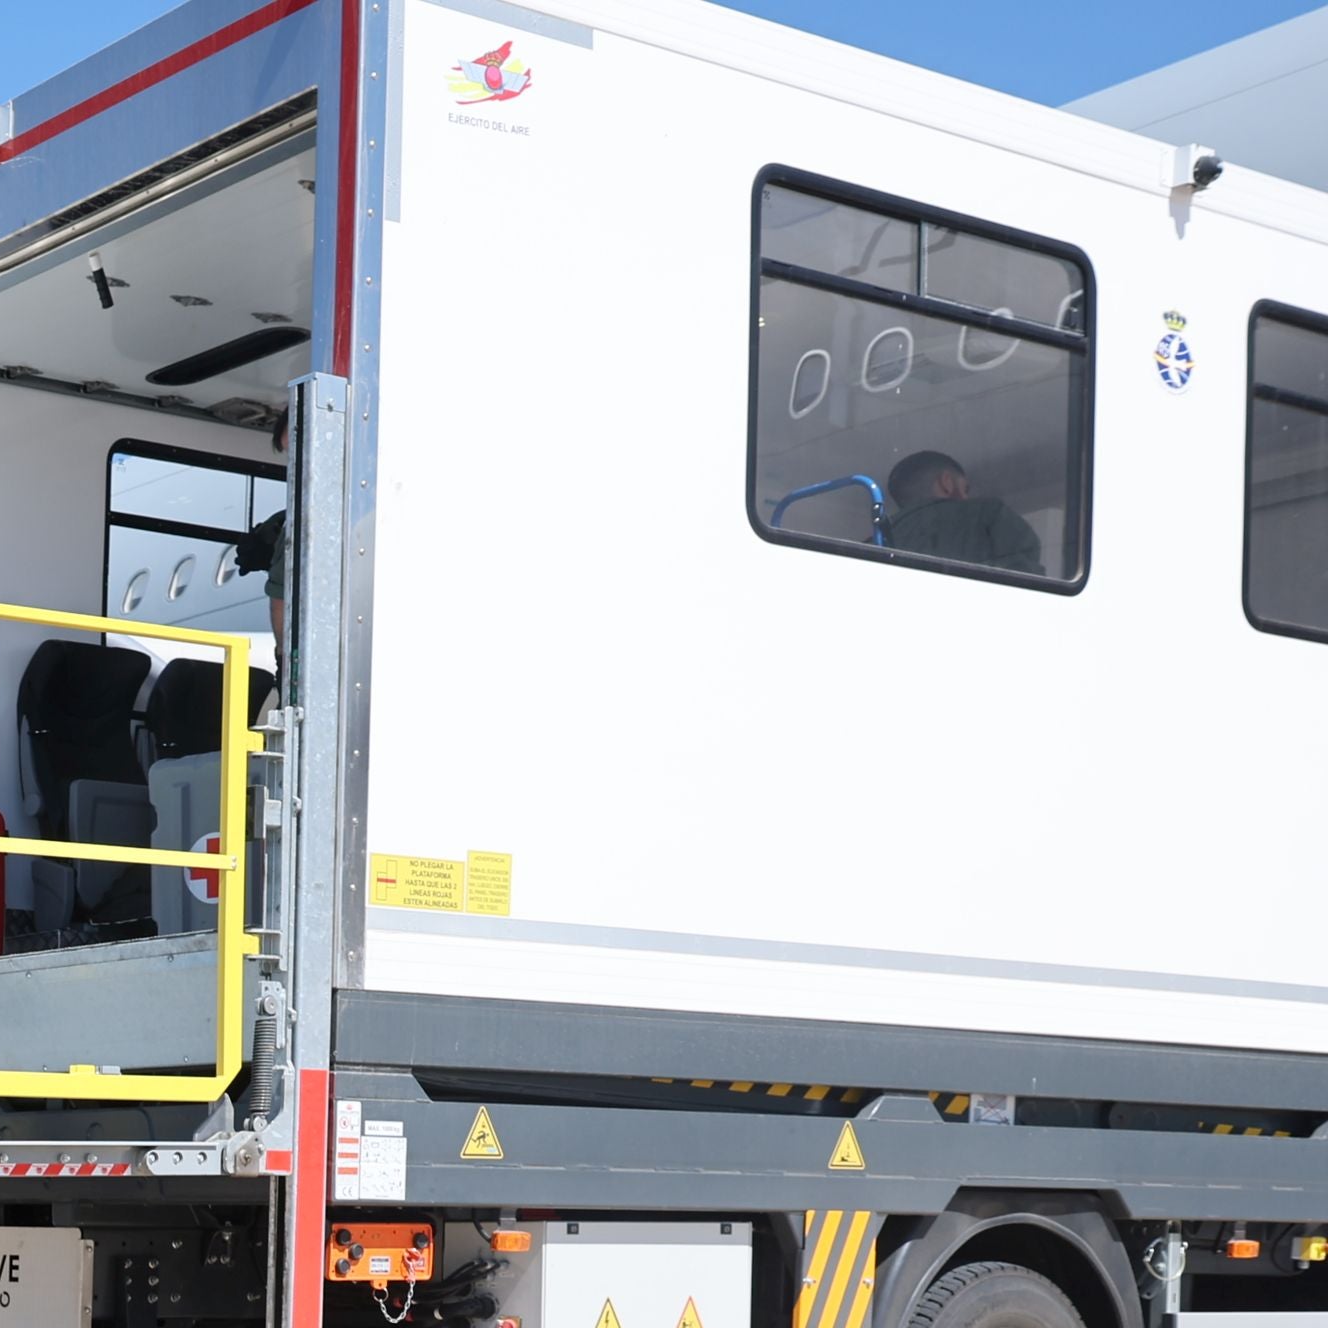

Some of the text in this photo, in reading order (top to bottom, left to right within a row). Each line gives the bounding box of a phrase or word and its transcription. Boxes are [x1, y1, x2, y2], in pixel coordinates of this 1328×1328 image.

[492, 121, 508, 133] DEL
[511, 125, 530, 136] AIRE
[410, 860, 419, 868] NO
[420, 861, 444, 870] PLEGAR
[411, 869, 451, 880] PLATAFORMA
[405, 879, 424, 887] HASTA
[426, 880, 439, 888] QUE
[432, 891, 452, 899] ROJAS
[424, 899, 458, 908] ALINEADAS
